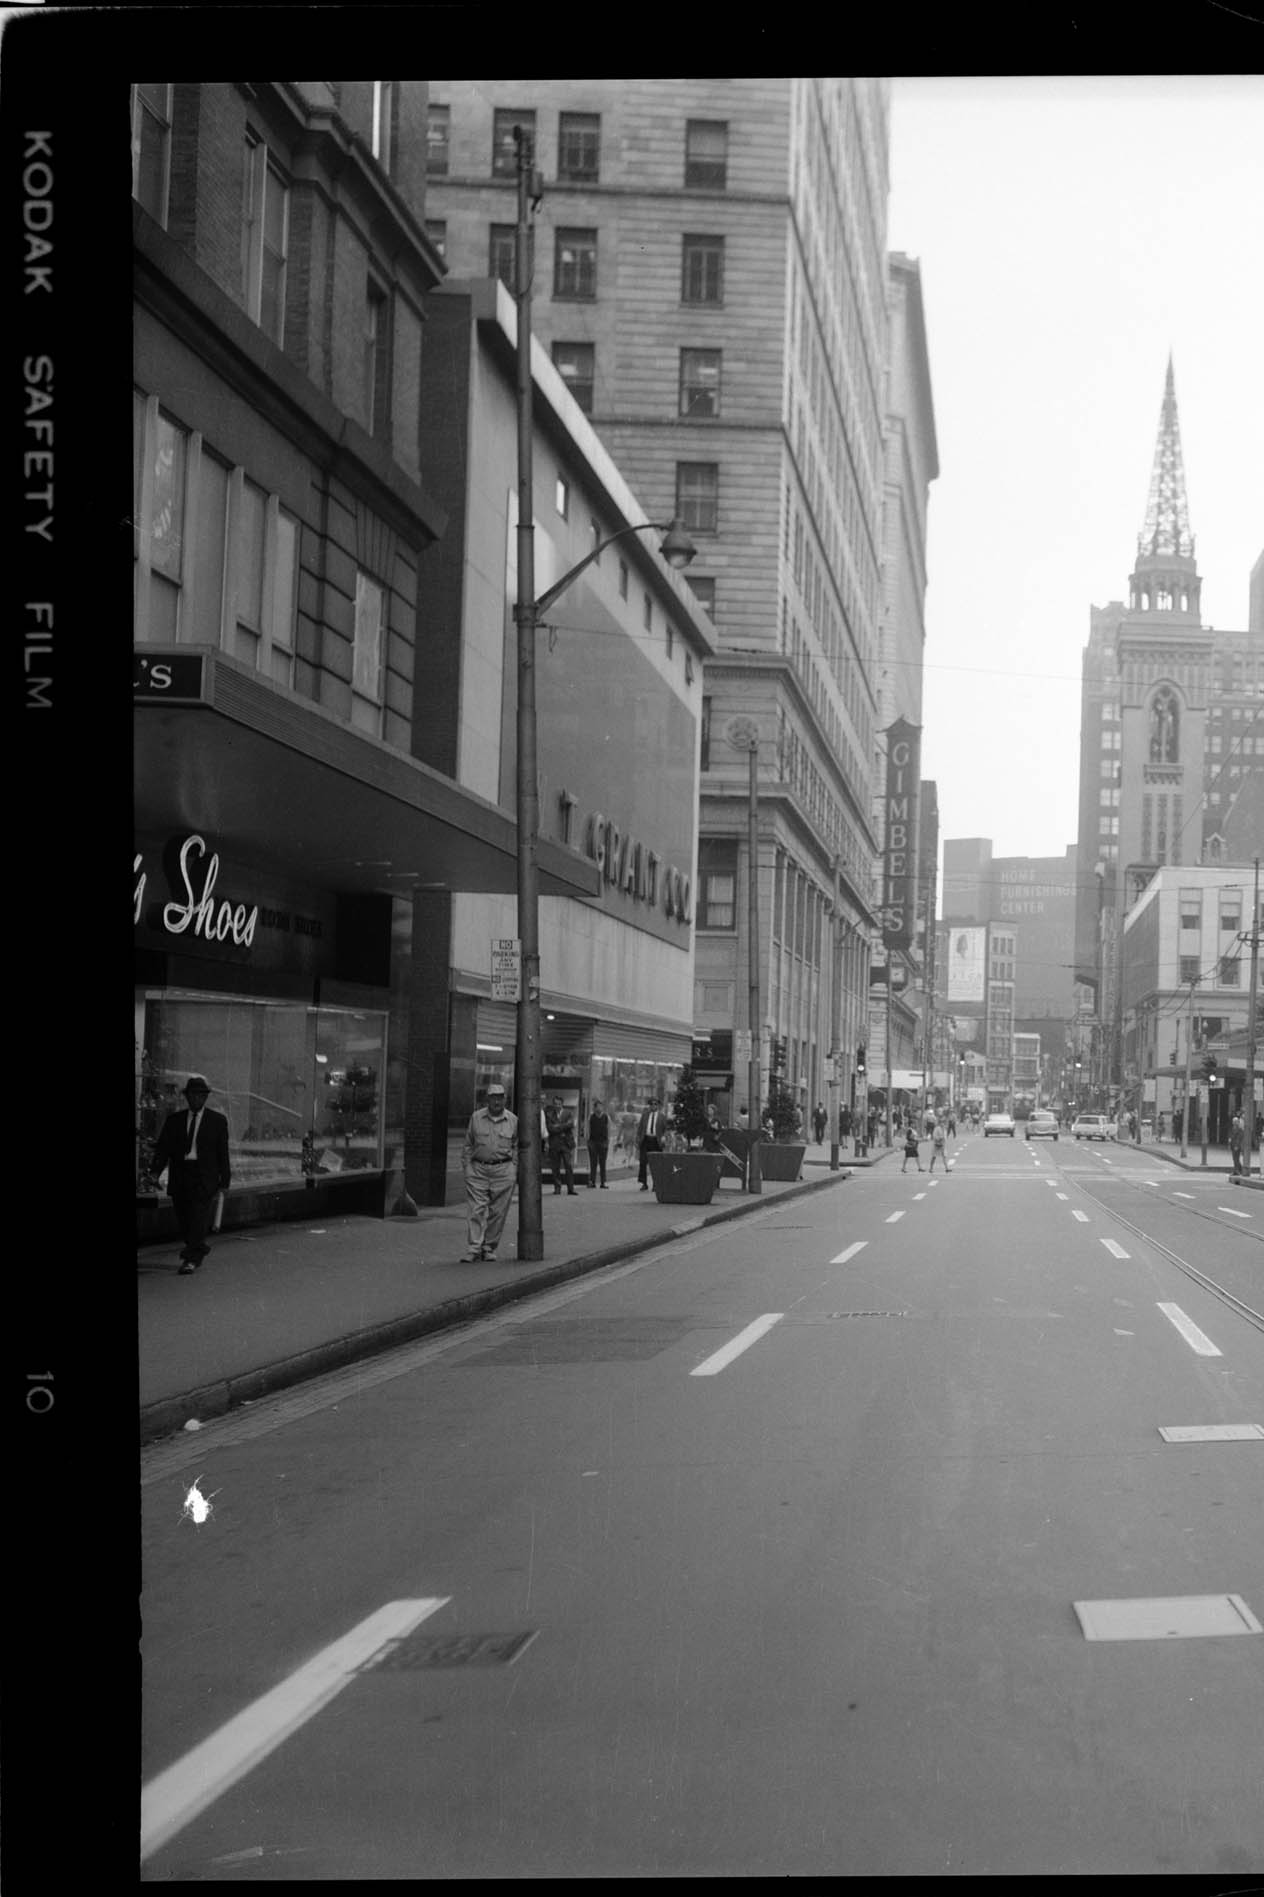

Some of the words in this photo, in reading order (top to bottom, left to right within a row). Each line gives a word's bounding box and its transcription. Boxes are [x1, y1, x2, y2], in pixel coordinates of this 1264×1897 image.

[23, 130, 54, 295] KODAK
[23, 354, 54, 543] SAFETY
[24, 603, 54, 709] FILM
[587, 809, 662, 907] GRANT
[887, 741, 910, 933] GIMBELS
[1001, 867, 1037, 883] HOME
[163, 834, 259, 948] Shoes
[1000, 882, 1078, 899] FURNISHINGS
[1000, 901, 1045, 916] CENTER
[500, 940, 513, 950] NO
[26, 1370, 54, 1414] 10
